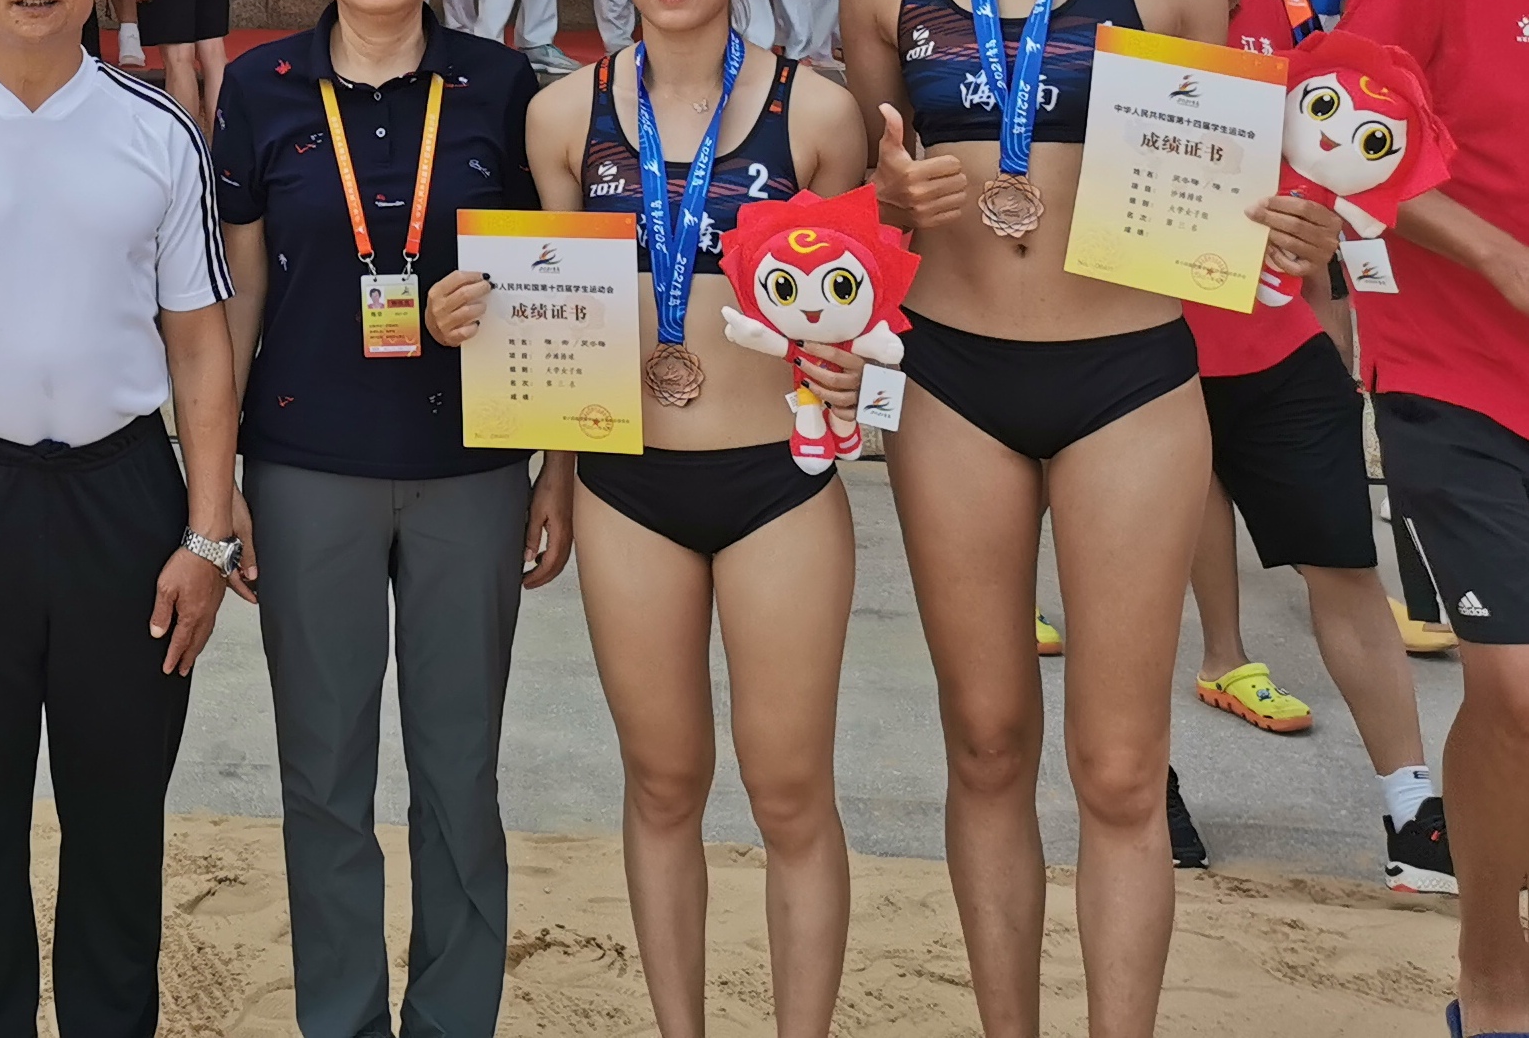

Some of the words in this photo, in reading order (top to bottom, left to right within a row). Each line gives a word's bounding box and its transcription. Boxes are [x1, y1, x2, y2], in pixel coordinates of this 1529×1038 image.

[1114, 103, 1256, 140] 中华人民共和国第十四届学生运动会
[1140, 131, 1224, 162] 成绩证书
[748, 162, 769, 199] 2
[511, 303, 587, 321] 成绩证书
